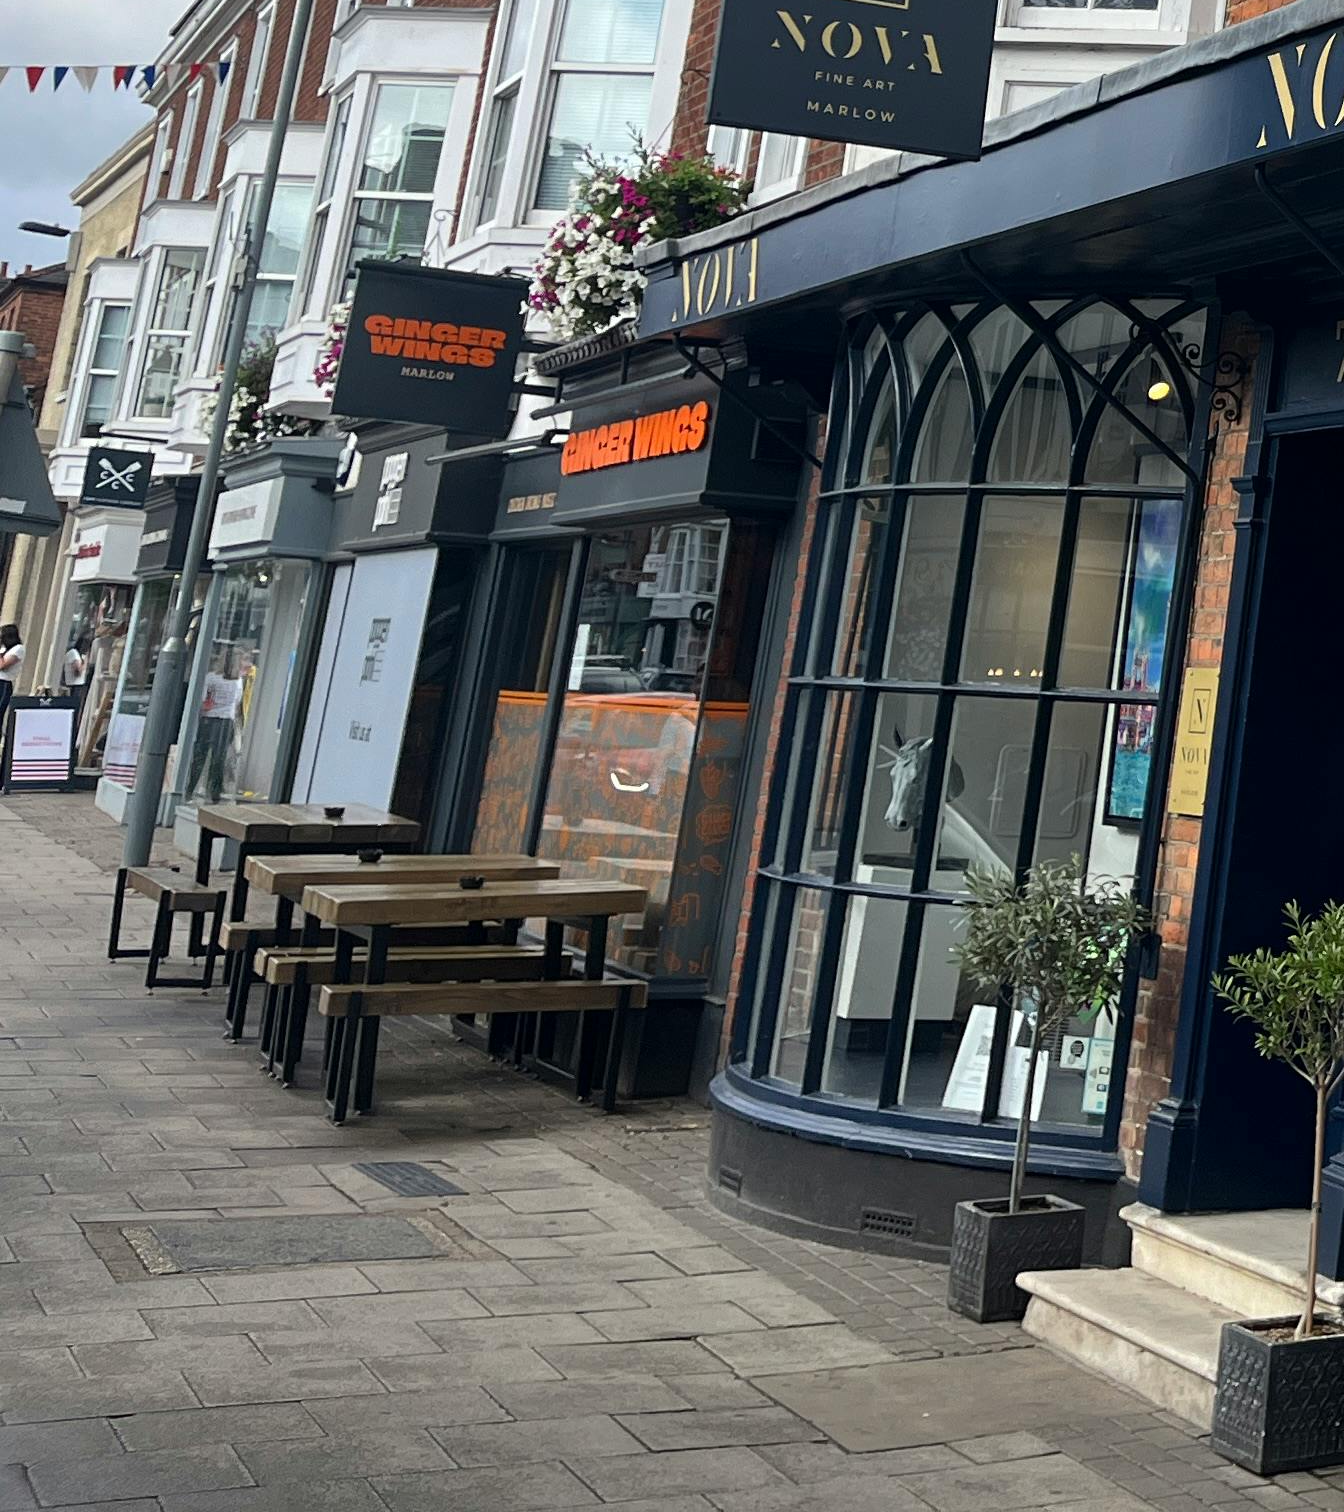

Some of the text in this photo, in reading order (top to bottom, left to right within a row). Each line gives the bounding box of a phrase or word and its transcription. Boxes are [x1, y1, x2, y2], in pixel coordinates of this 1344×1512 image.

[771, 10, 943, 74] NOVA
[815, 71, 897, 92] FINE ART
[807, 100, 896, 123] MARLOW
[672, 238, 758, 322] NOVA
[364, 314, 507, 350] GINGER
[370, 335, 495, 368] WINGS
[400, 366, 454, 381] MARLOW
[561, 400, 709, 476] GINGER WINGS
